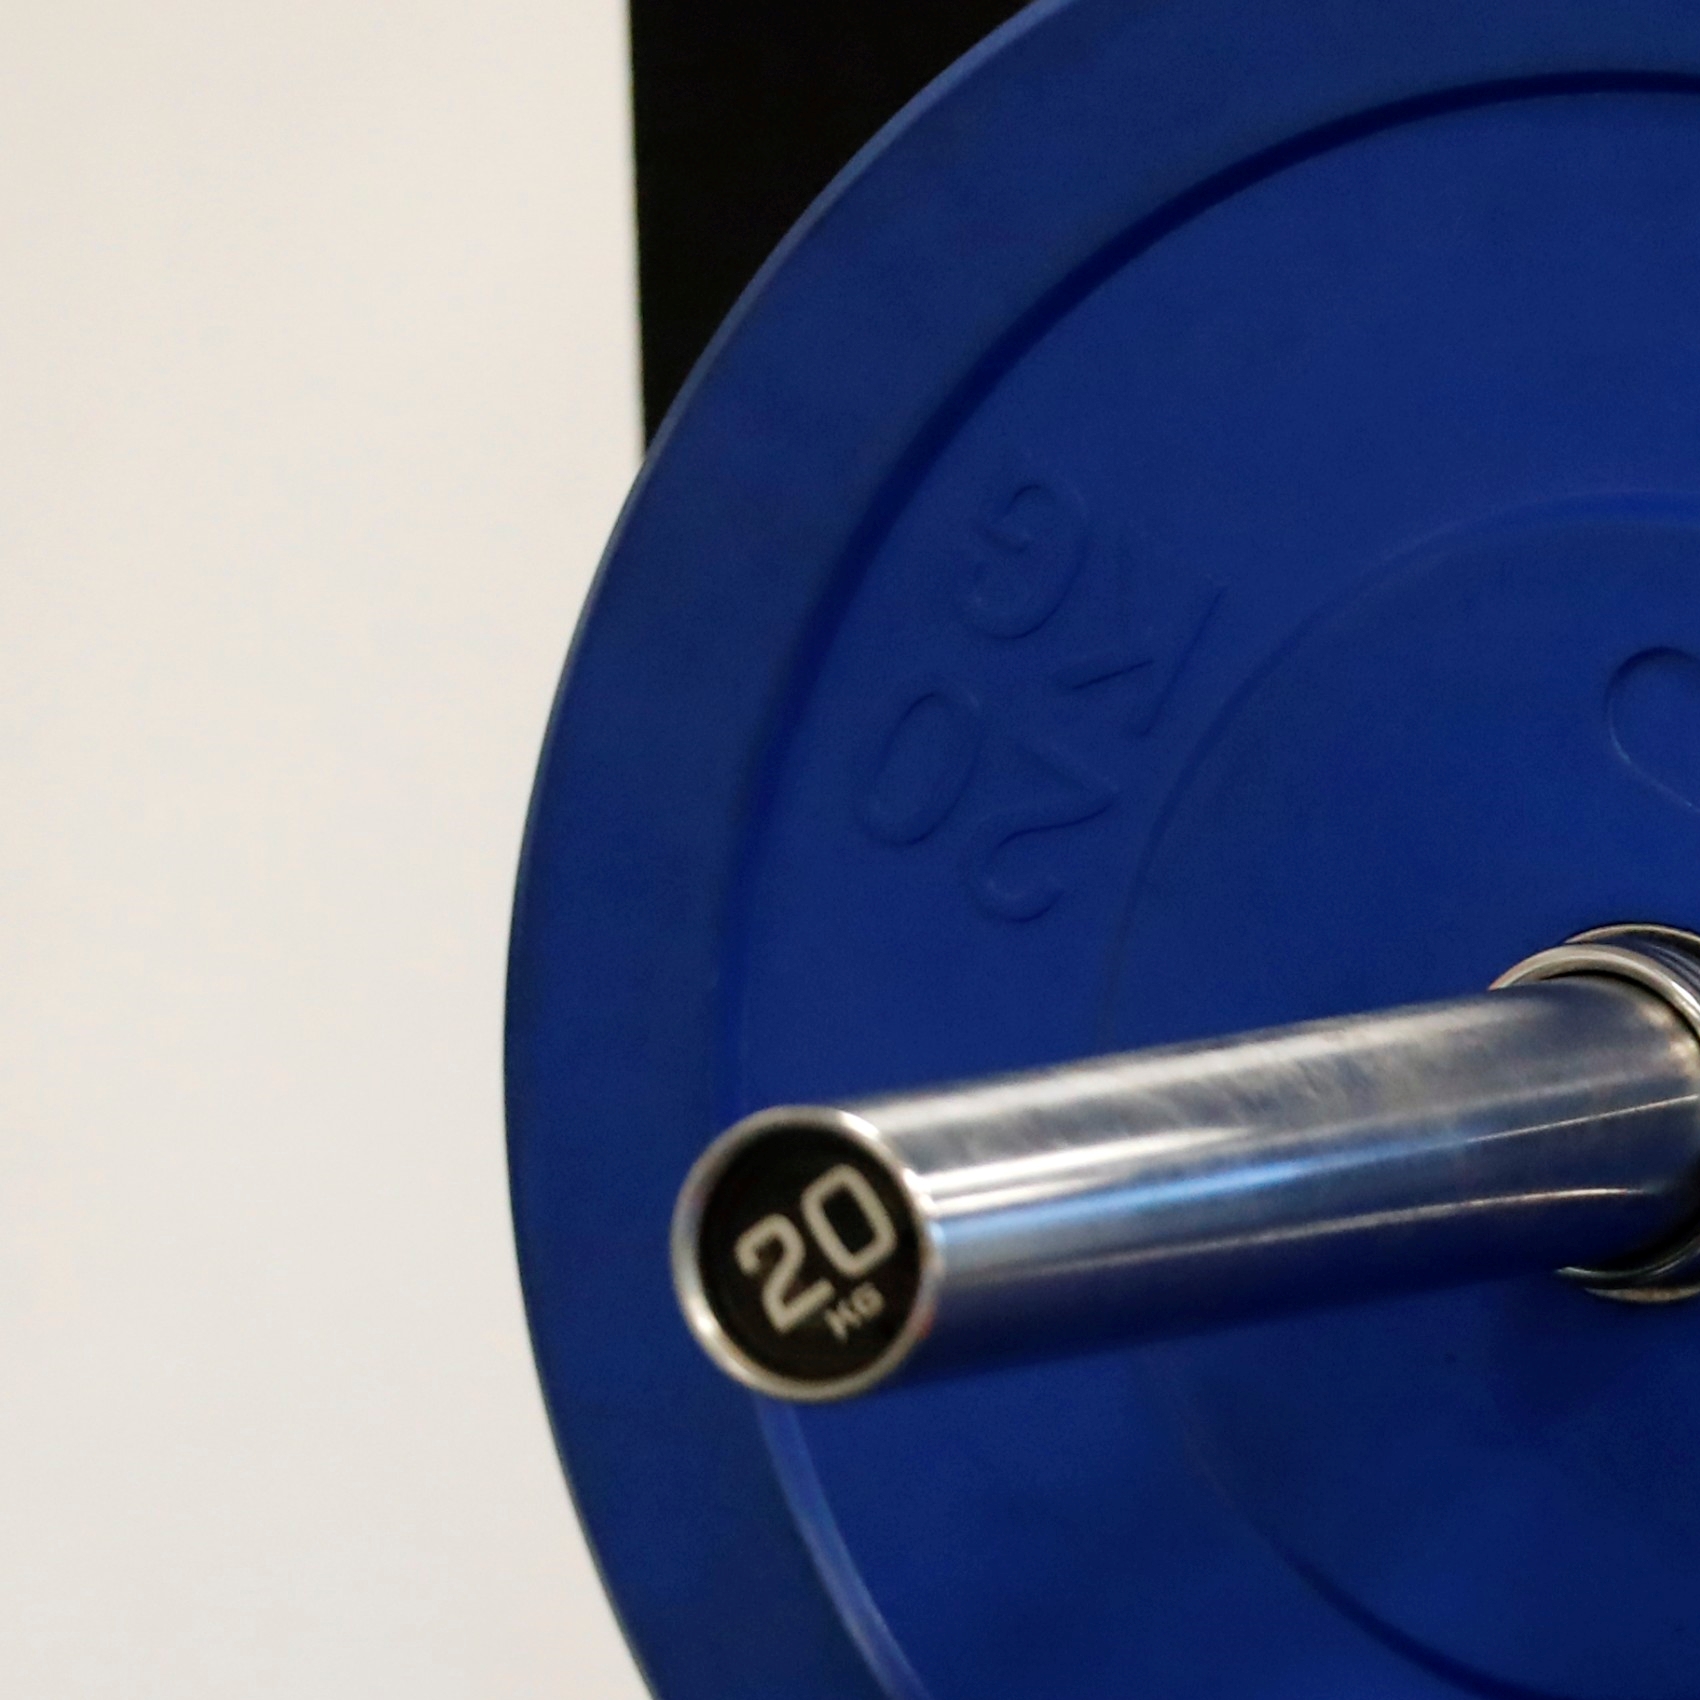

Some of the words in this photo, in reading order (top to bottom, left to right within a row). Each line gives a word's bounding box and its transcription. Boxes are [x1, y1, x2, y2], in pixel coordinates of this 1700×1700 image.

[953, 475, 1228, 738] KG
[850, 682, 1122, 926] 20
[735, 1163, 897, 1334] 20
